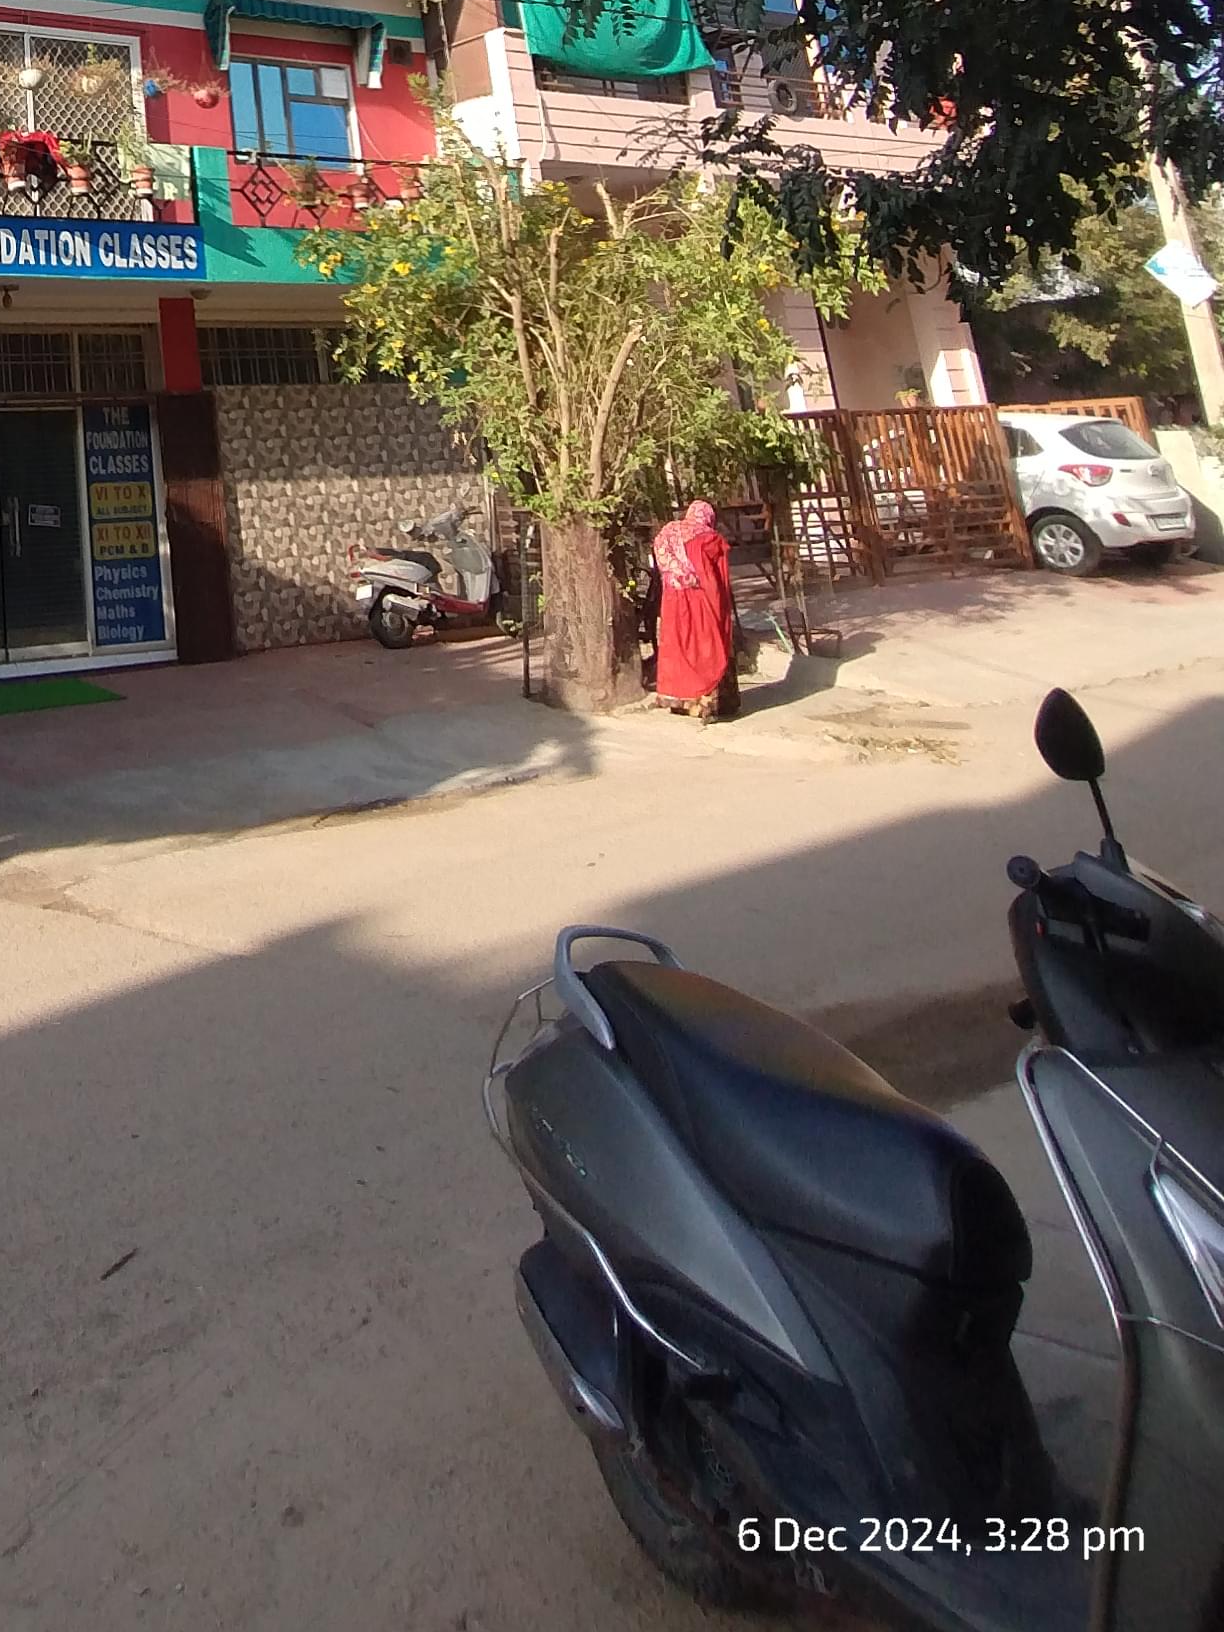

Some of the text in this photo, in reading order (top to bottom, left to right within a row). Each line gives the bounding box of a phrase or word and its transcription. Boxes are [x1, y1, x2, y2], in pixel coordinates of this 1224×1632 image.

[98, 232, 198, 270] CLASSES
[102, 407, 130, 425] THE
[86, 430, 148, 450] FOUNDATION
[89, 454, 149, 475] CLASSES
[96, 485, 146, 501] VI TO X
[97, 524, 152, 542] XI TO XII
[100, 545, 125, 556] PCM
[95, 564, 147, 585] Physics
[96, 584, 159, 601] Chemistry
[96, 604, 136, 620] Maths
[97, 624, 145, 642] Biology
